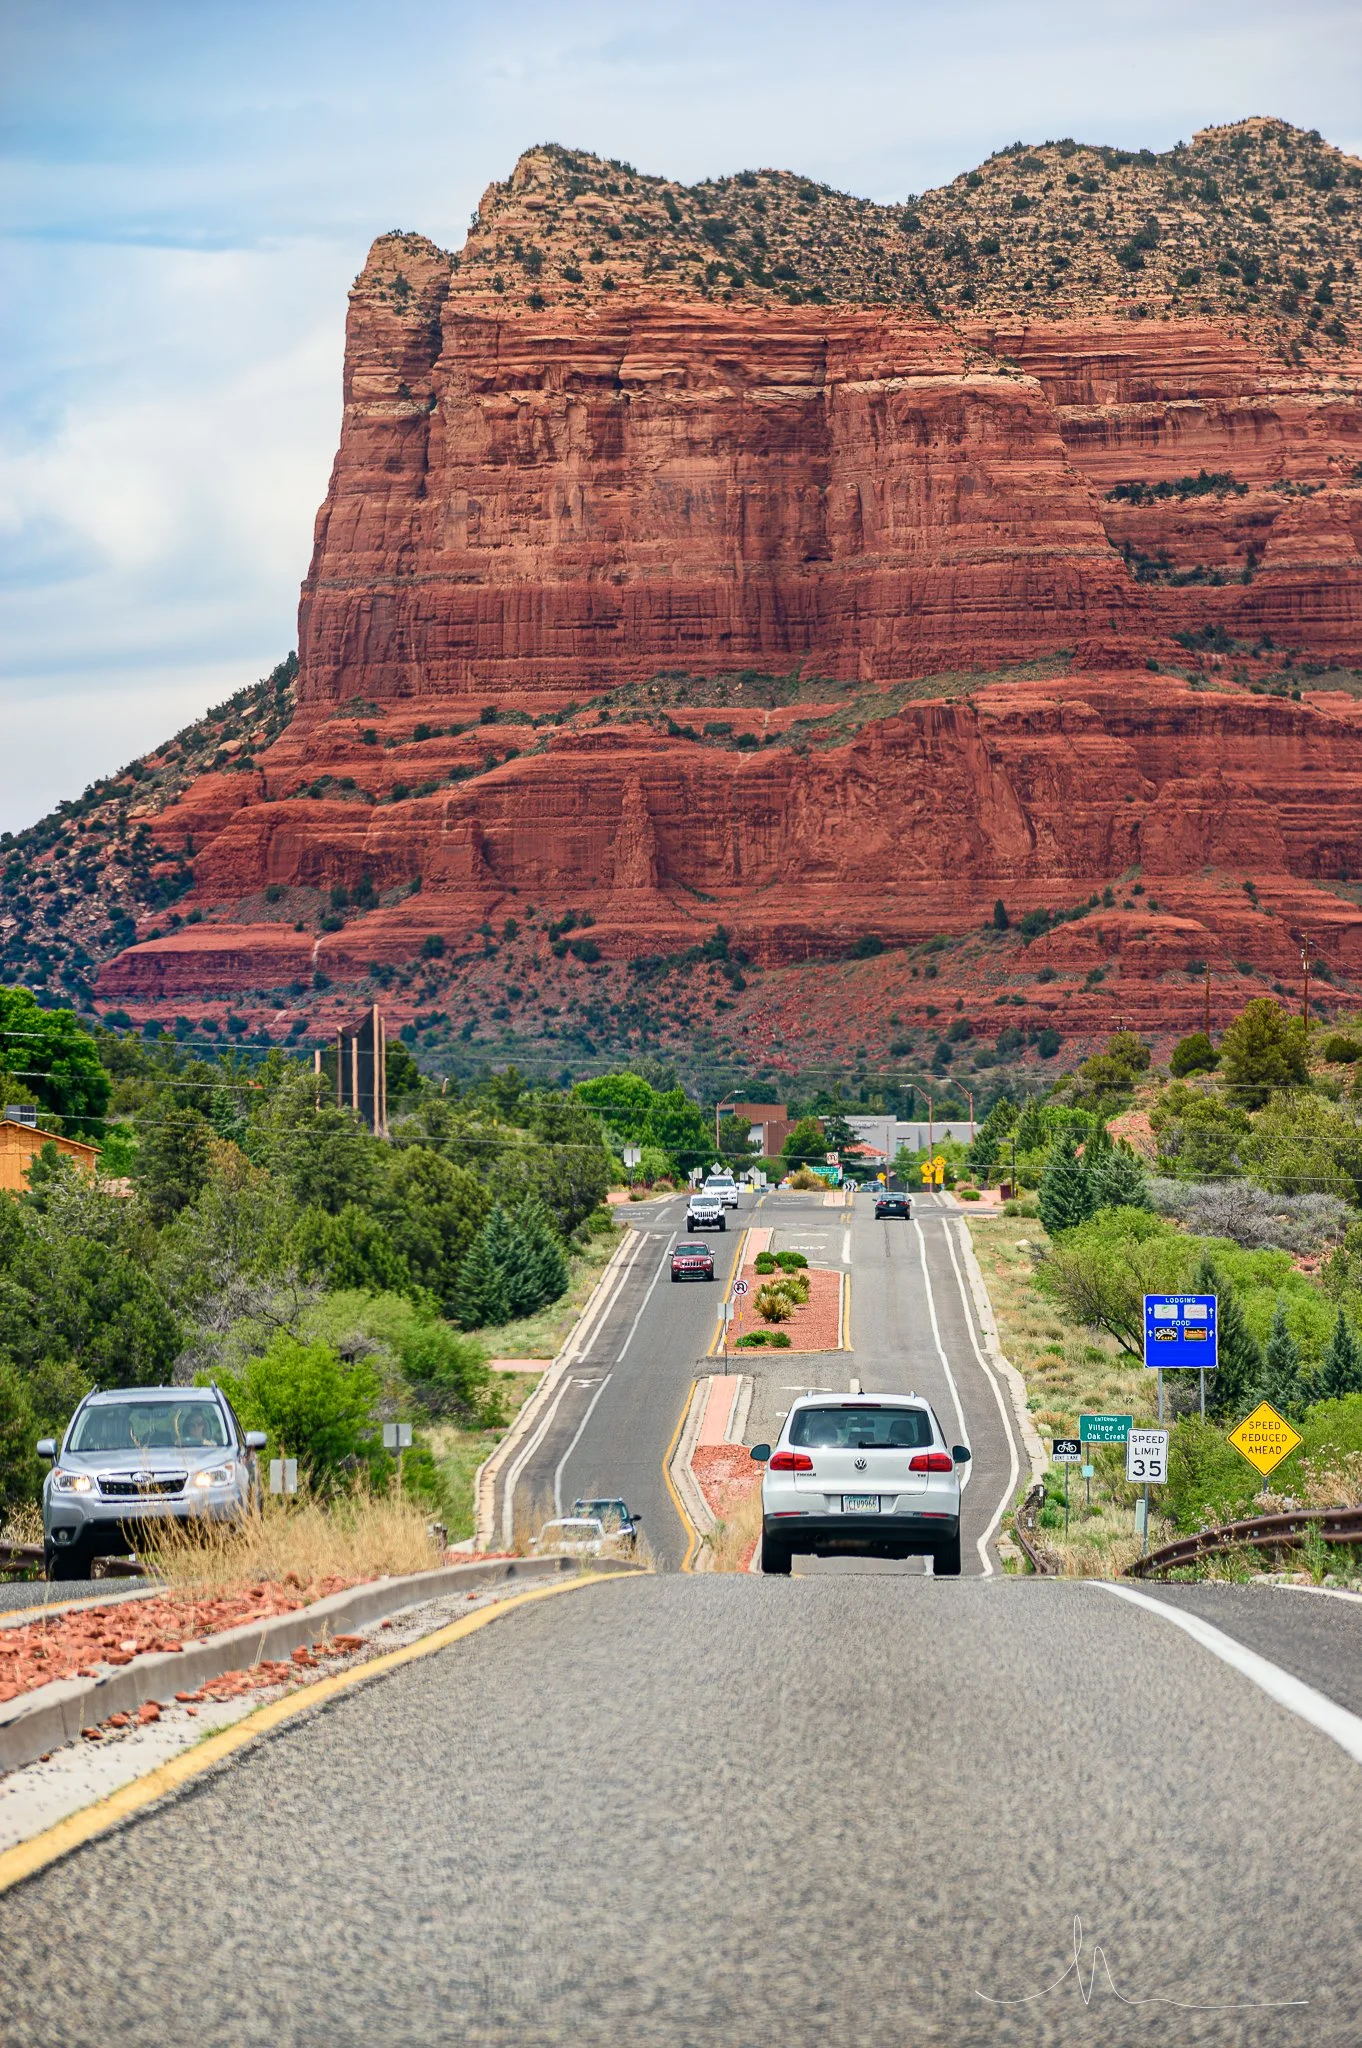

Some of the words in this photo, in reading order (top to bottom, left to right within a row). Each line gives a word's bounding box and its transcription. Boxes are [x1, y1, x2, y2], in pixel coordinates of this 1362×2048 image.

[1088, 1423, 1114, 1432] Village
[1248, 1421, 1281, 1430] SPEED
[1086, 1432, 1101, 1440] Oak
[1104, 1432, 1126, 1440] Creek
[1131, 1435, 1165, 1444] SPEED
[1241, 1433, 1288, 1442] REDUCED
[1134, 1447, 1161, 1456] LIMIT
[1247, 1445, 1282, 1455] AHEAD
[1132, 1459, 1162, 1477] 35
